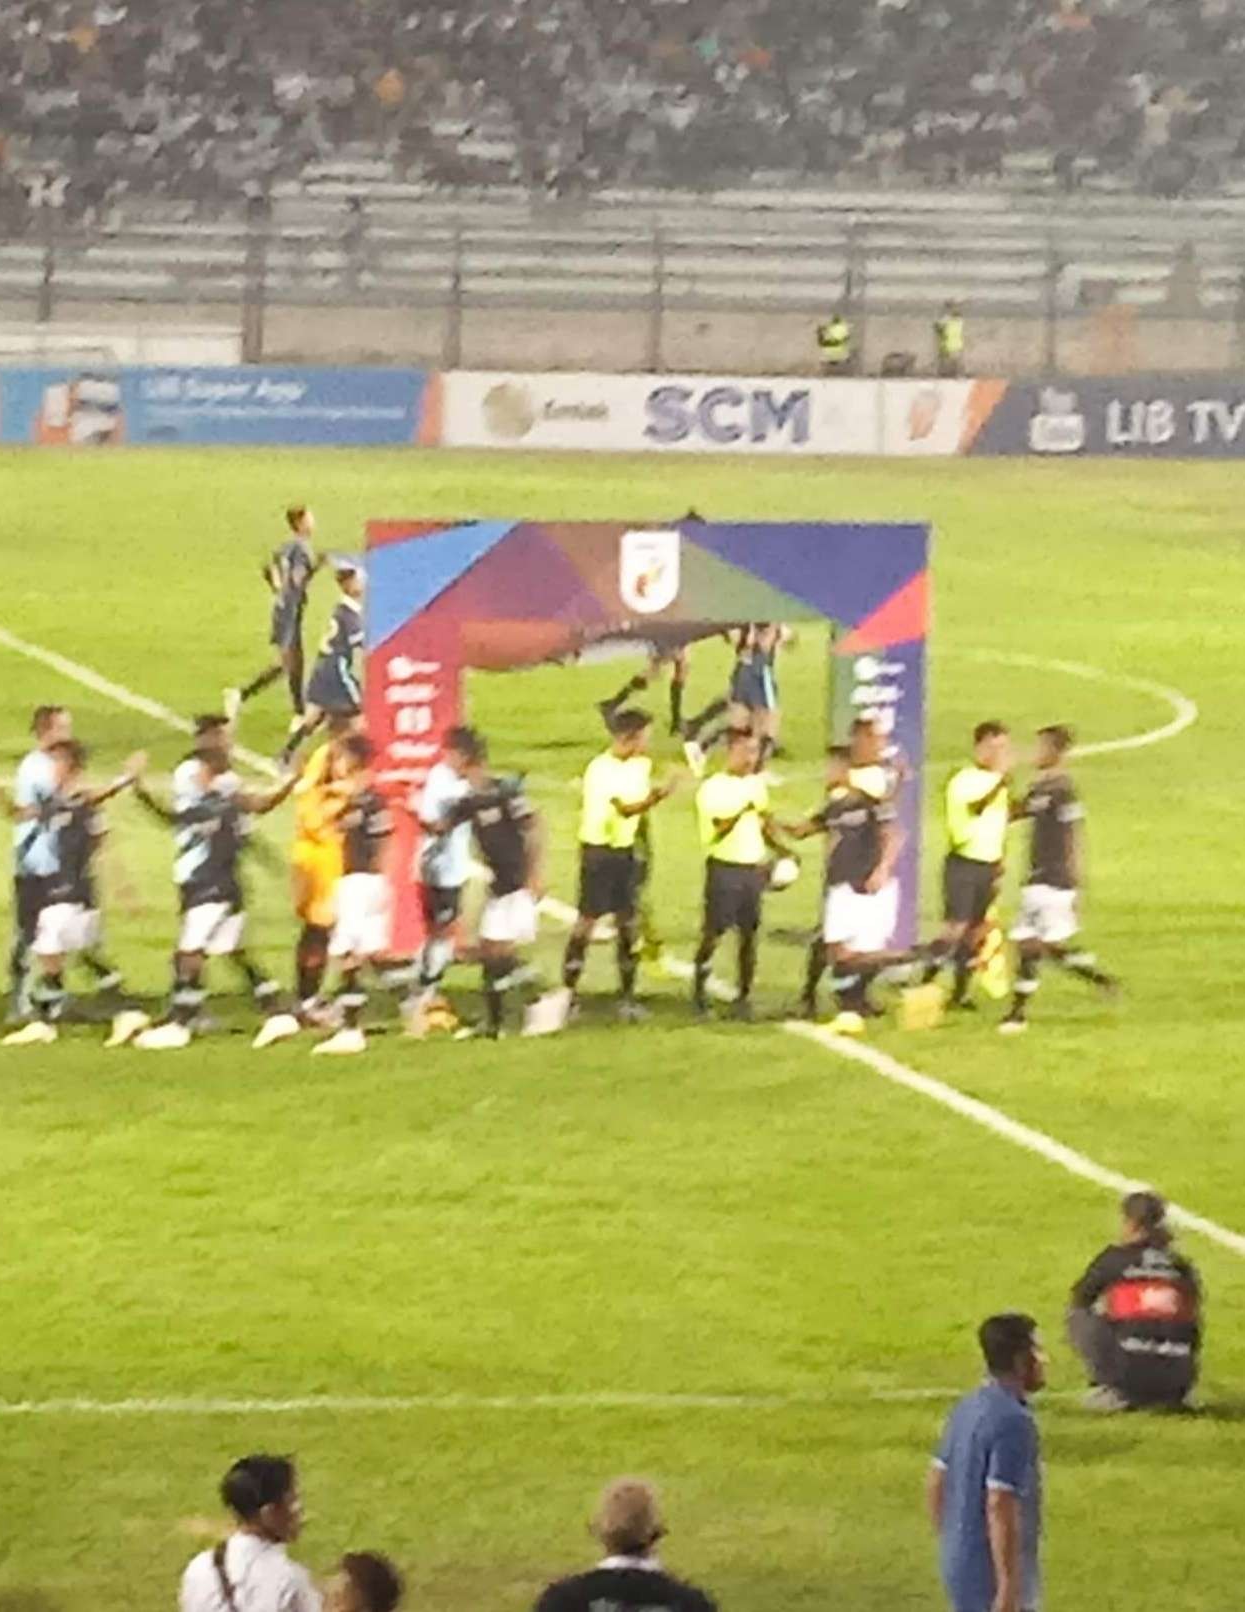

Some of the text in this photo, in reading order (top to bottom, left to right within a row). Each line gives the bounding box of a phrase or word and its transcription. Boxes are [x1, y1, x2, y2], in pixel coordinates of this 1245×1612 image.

[642, 385, 811, 443] SCM
[1105, 398, 1245, 445] LIB TV
